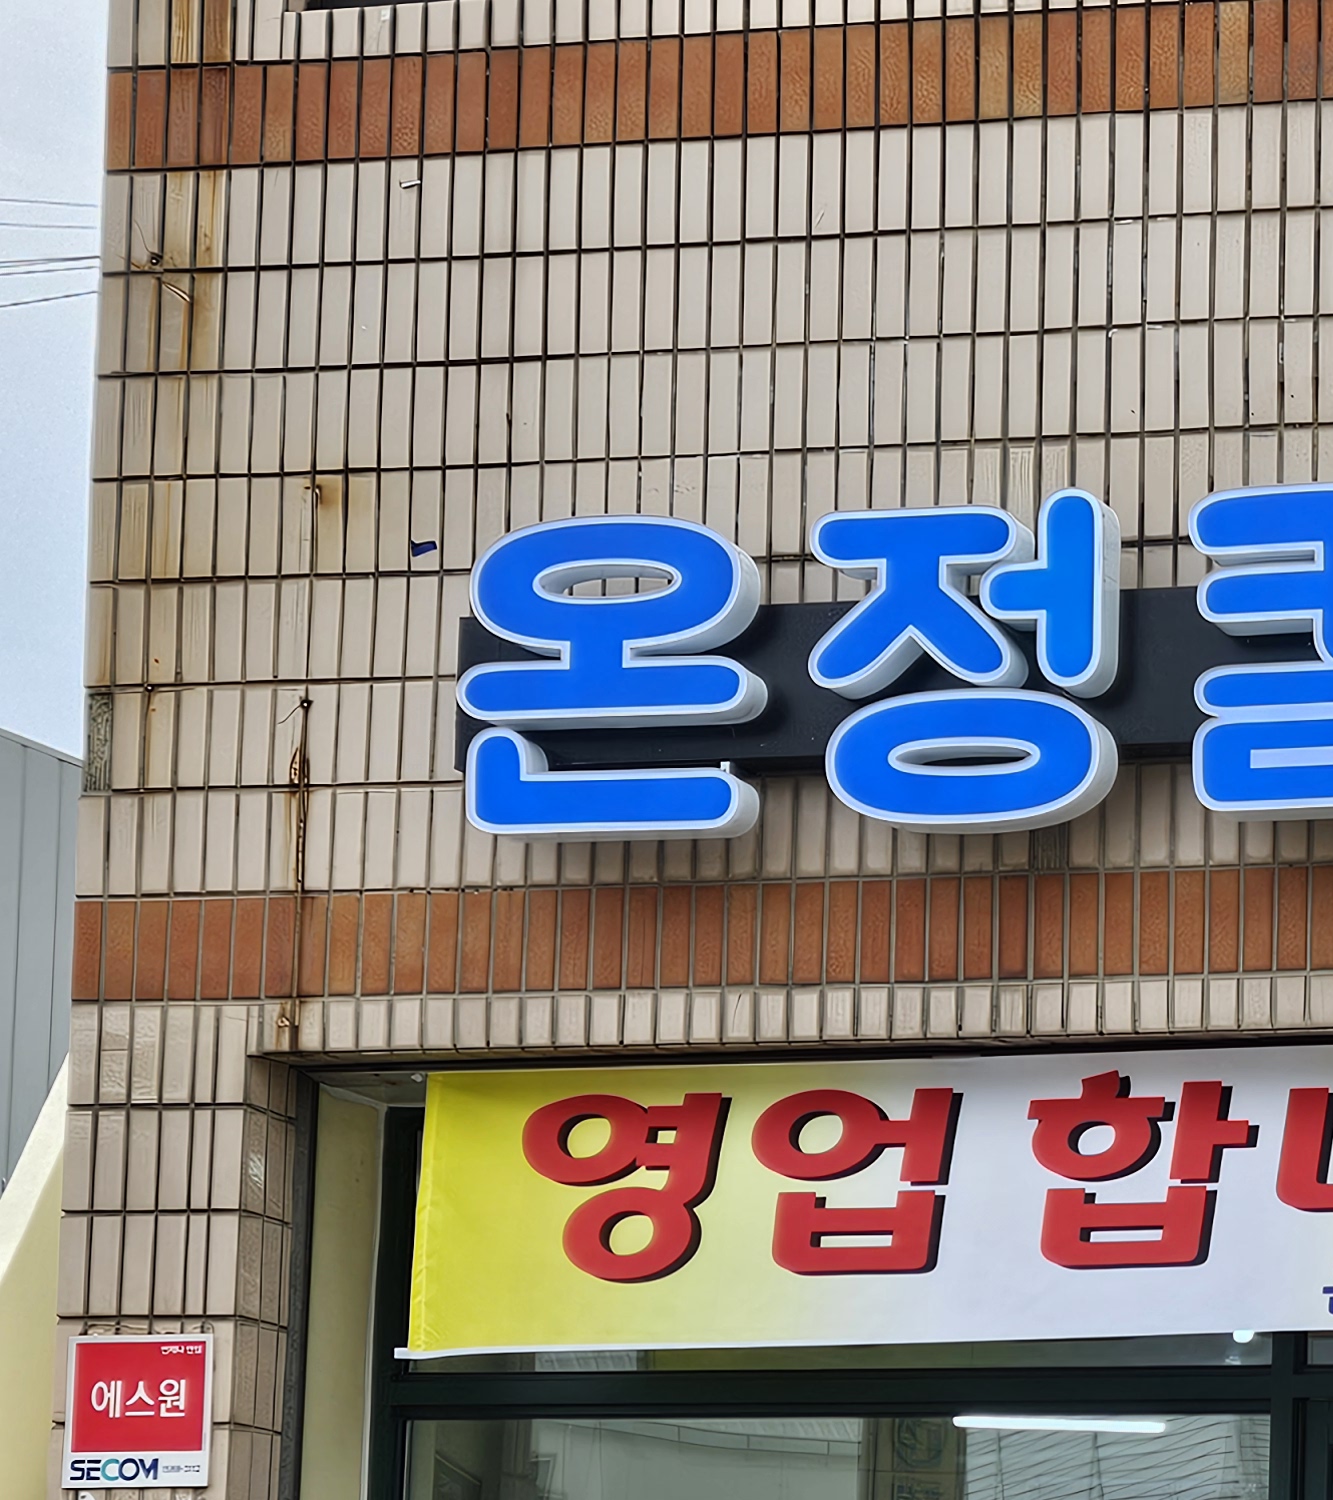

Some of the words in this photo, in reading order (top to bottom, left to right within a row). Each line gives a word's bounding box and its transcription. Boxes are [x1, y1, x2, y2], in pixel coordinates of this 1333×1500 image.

[522, 1086, 955, 1284] 영업
[90, 1379, 187, 1418] 에스원
[69, 1458, 159, 1481] SECOM
